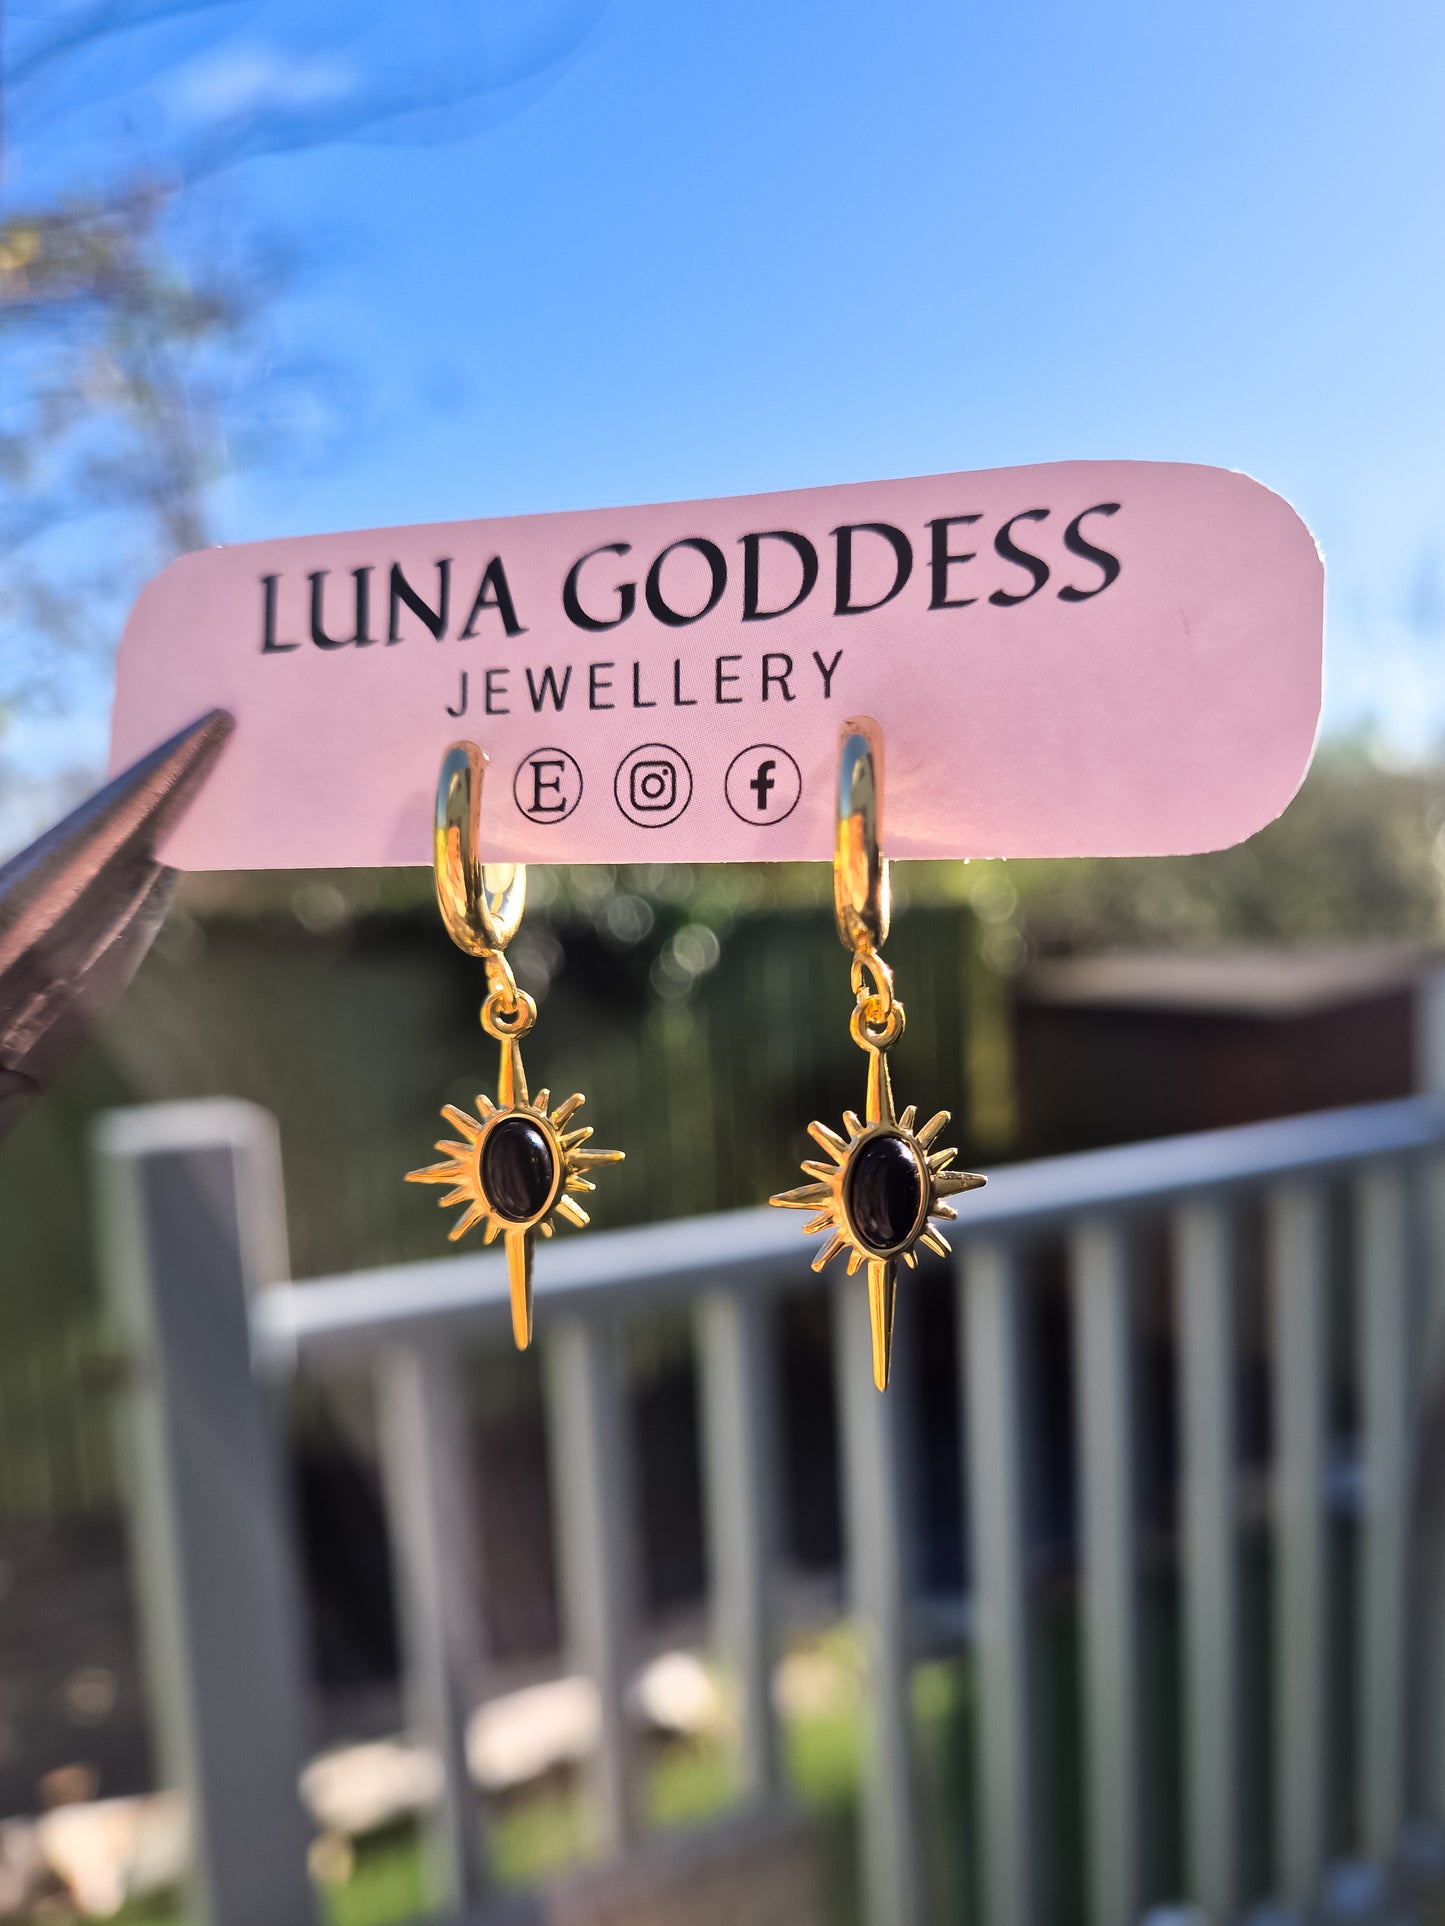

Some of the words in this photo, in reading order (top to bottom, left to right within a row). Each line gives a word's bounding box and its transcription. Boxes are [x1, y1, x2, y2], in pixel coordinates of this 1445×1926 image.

[261, 555, 529, 654] LUNA
[563, 502, 1121, 633] GODDESS
[446, 649, 844, 718] JEWELLERY
